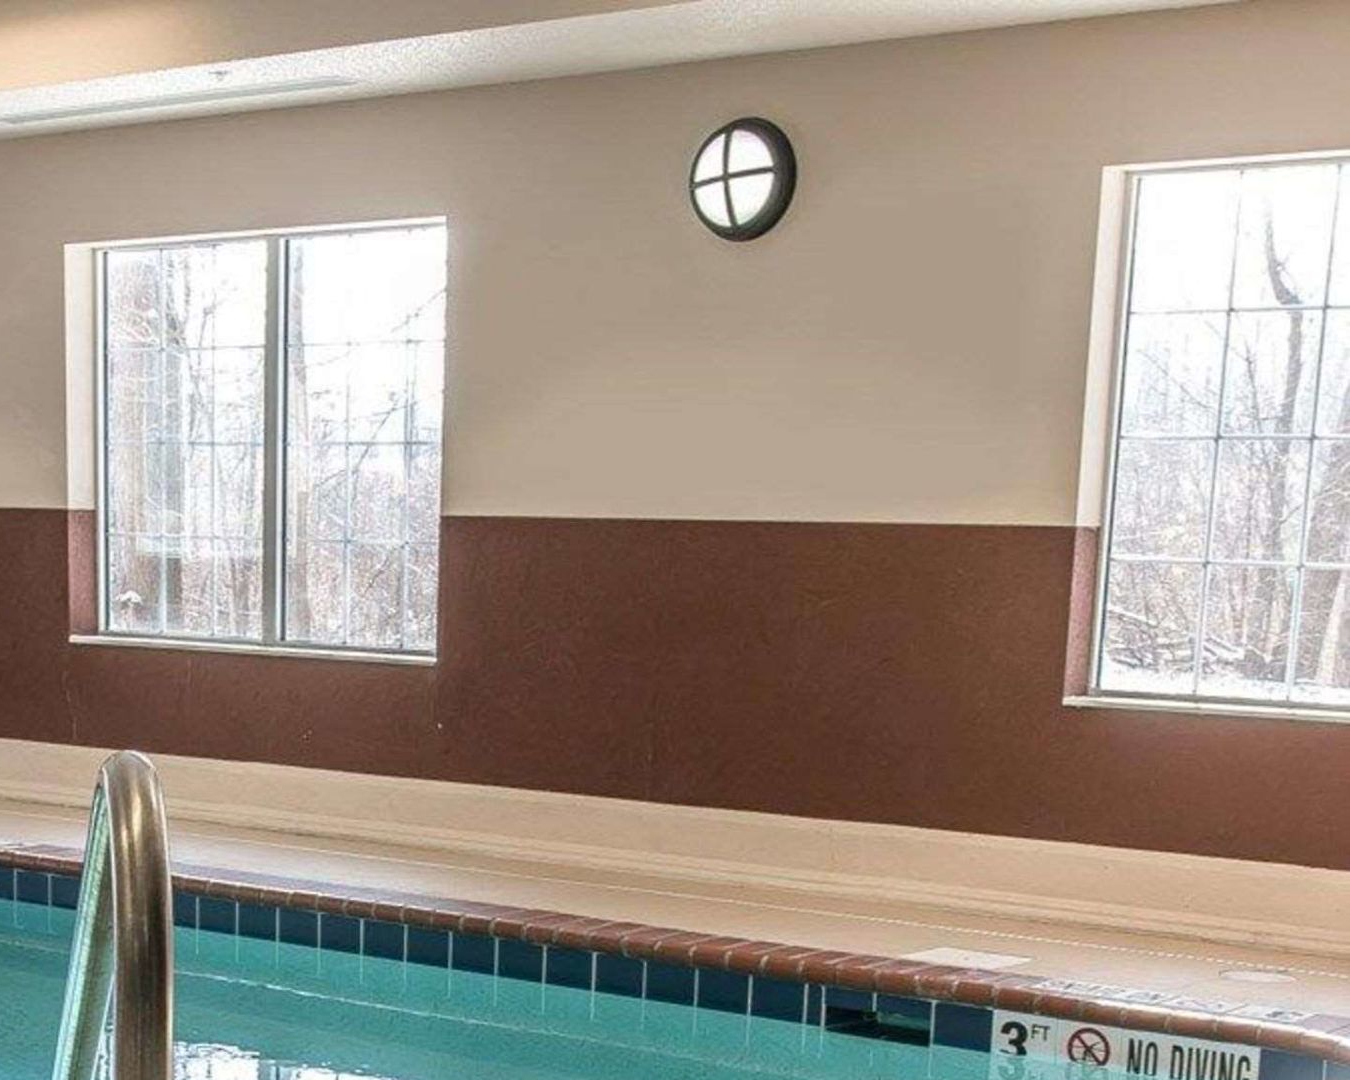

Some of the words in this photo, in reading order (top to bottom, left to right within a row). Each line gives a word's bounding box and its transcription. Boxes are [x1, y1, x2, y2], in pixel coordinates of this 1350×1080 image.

[999, 1021, 1028, 1056] 3
[1031, 1024, 1050, 1041] FT
[1126, 1038, 1158, 1077] NO
